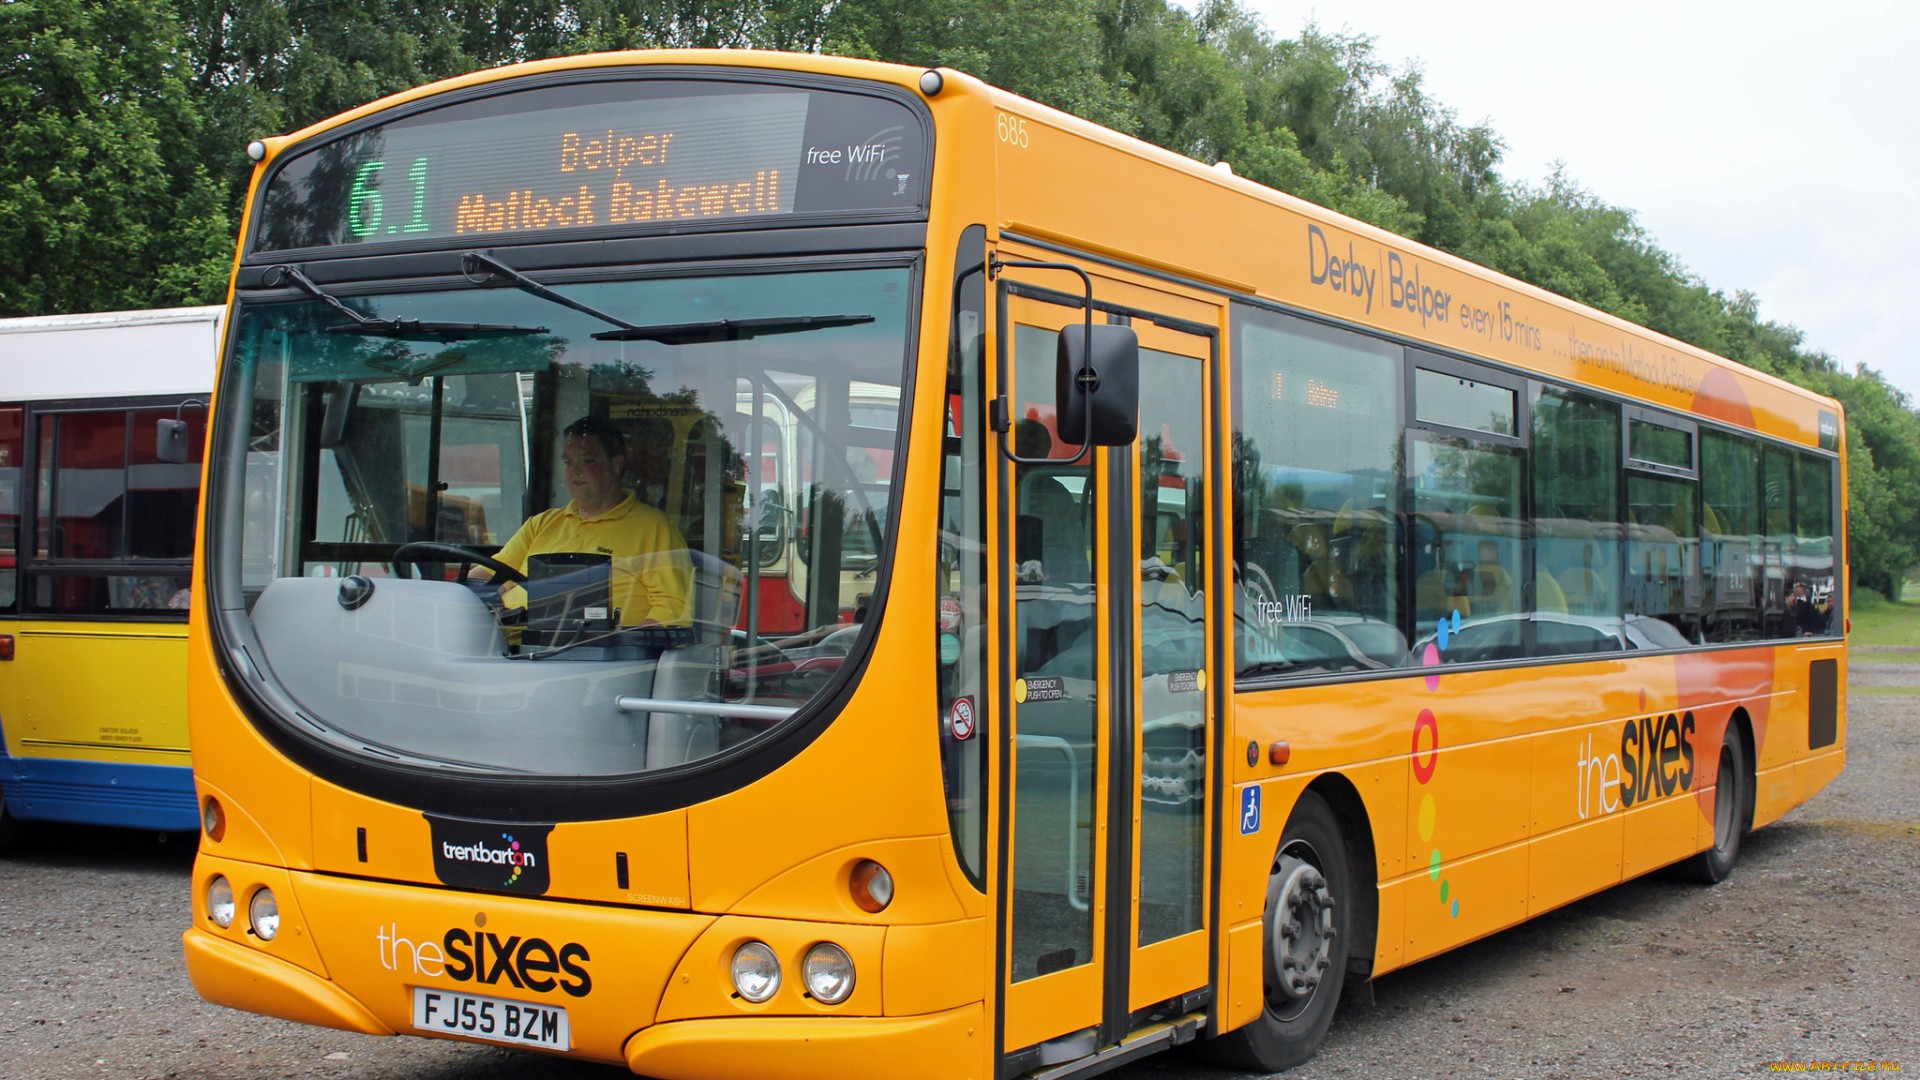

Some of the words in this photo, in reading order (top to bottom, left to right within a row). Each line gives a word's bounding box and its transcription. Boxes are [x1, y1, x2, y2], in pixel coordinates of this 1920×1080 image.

[997, 112, 1029, 149] 685
[561, 129, 674, 177] Belper
[806, 146, 842, 165] free
[847, 144, 886, 163] WiFi
[349, 157, 429, 237] 6.1
[456, 185, 596, 234] Matlock
[610, 169, 779, 222] Bakewell
[1307, 223, 1376, 315] Derby
[1388, 250, 1452, 330] Belper
[1460, 303, 1496, 342] every
[1498, 300, 1513, 342] 15
[1515, 316, 1541, 351] mins
[1597, 346, 1609, 370] on
[1610, 344, 1621, 375] to
[1621, 339, 1660, 387] Matlock
[1662, 353, 1671, 389] &
[1257, 593, 1283, 623] free
[1285, 594, 1312, 623] WiFi
[1027, 679, 1057, 690] EMERGENCY
[1027, 691, 1041, 700] PUSH
[1040, 690, 1048, 700] TO
[1048, 689, 1062, 699] OPEN
[443, 841, 535, 867] trentbarton
[627, 892, 686, 906] SCREENWASH
[425, 993, 495, 1034] FJ55
[505, 1004, 558, 1044] BZM
